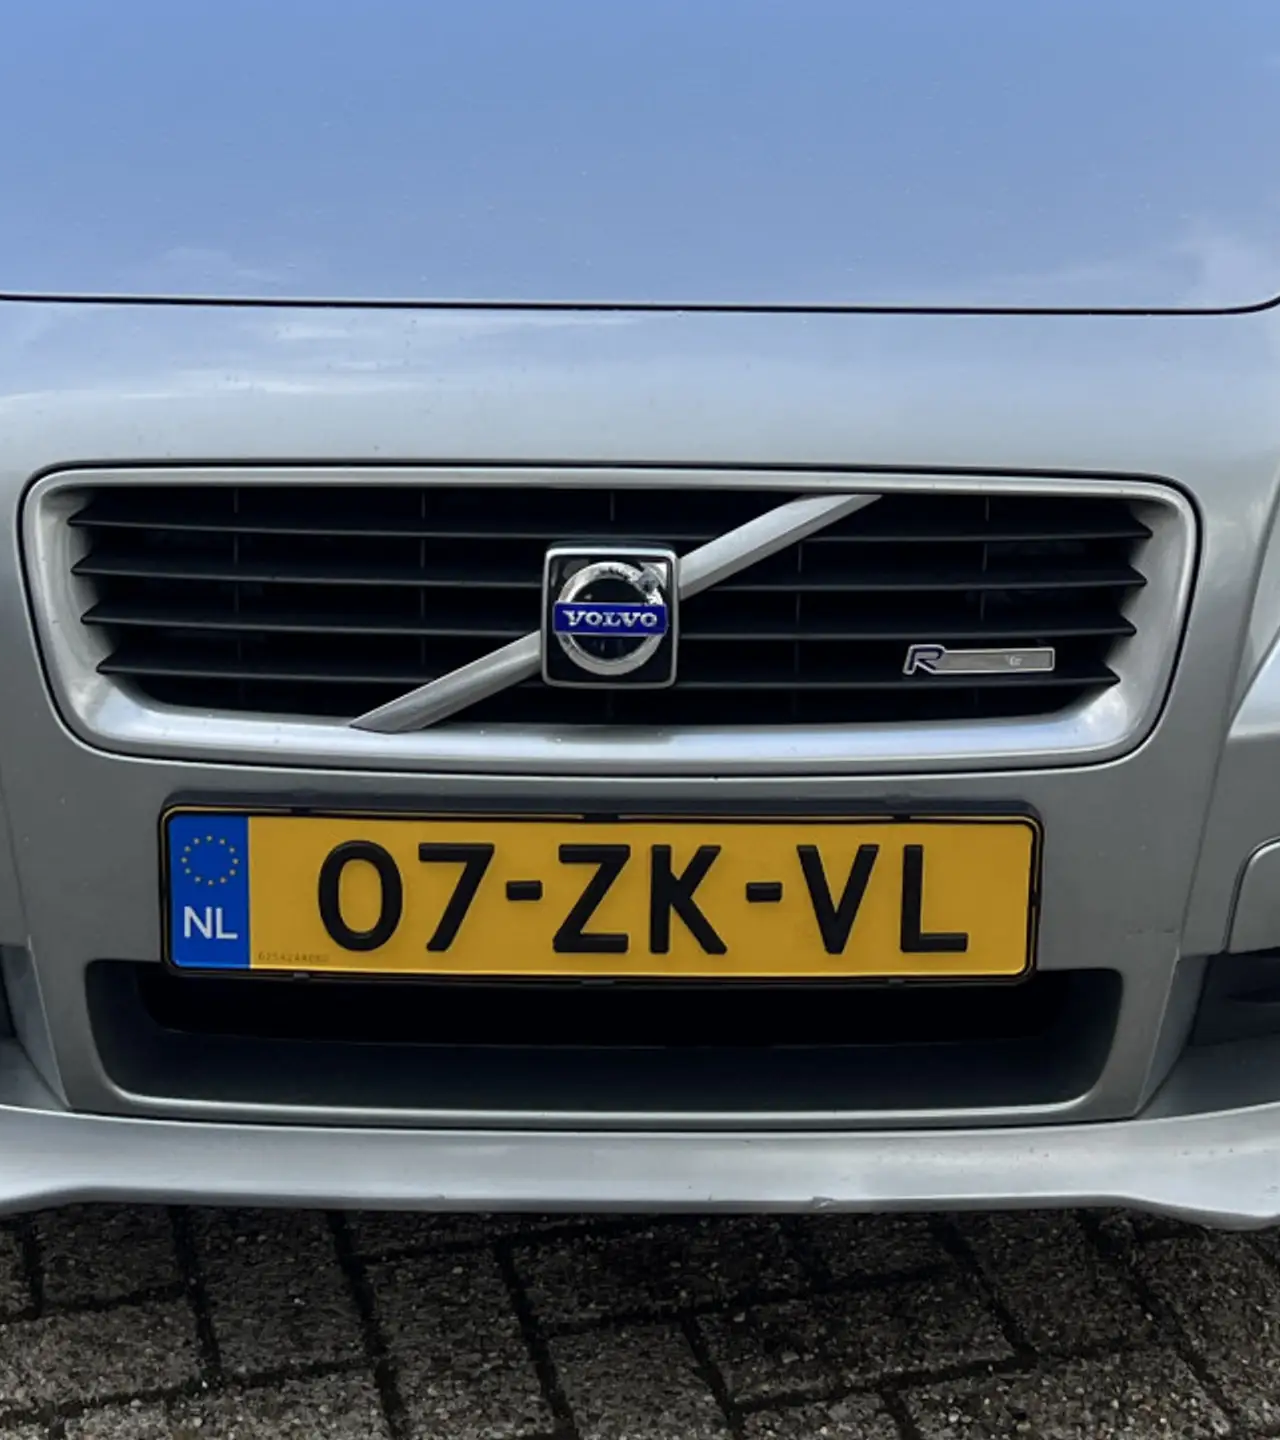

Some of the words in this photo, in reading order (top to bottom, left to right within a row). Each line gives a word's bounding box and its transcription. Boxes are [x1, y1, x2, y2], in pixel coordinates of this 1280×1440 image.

[562, 610, 658, 628] VOLVO
[317, 839, 970, 957] 07-ZK-VL
[182, 905, 238, 941] NL
